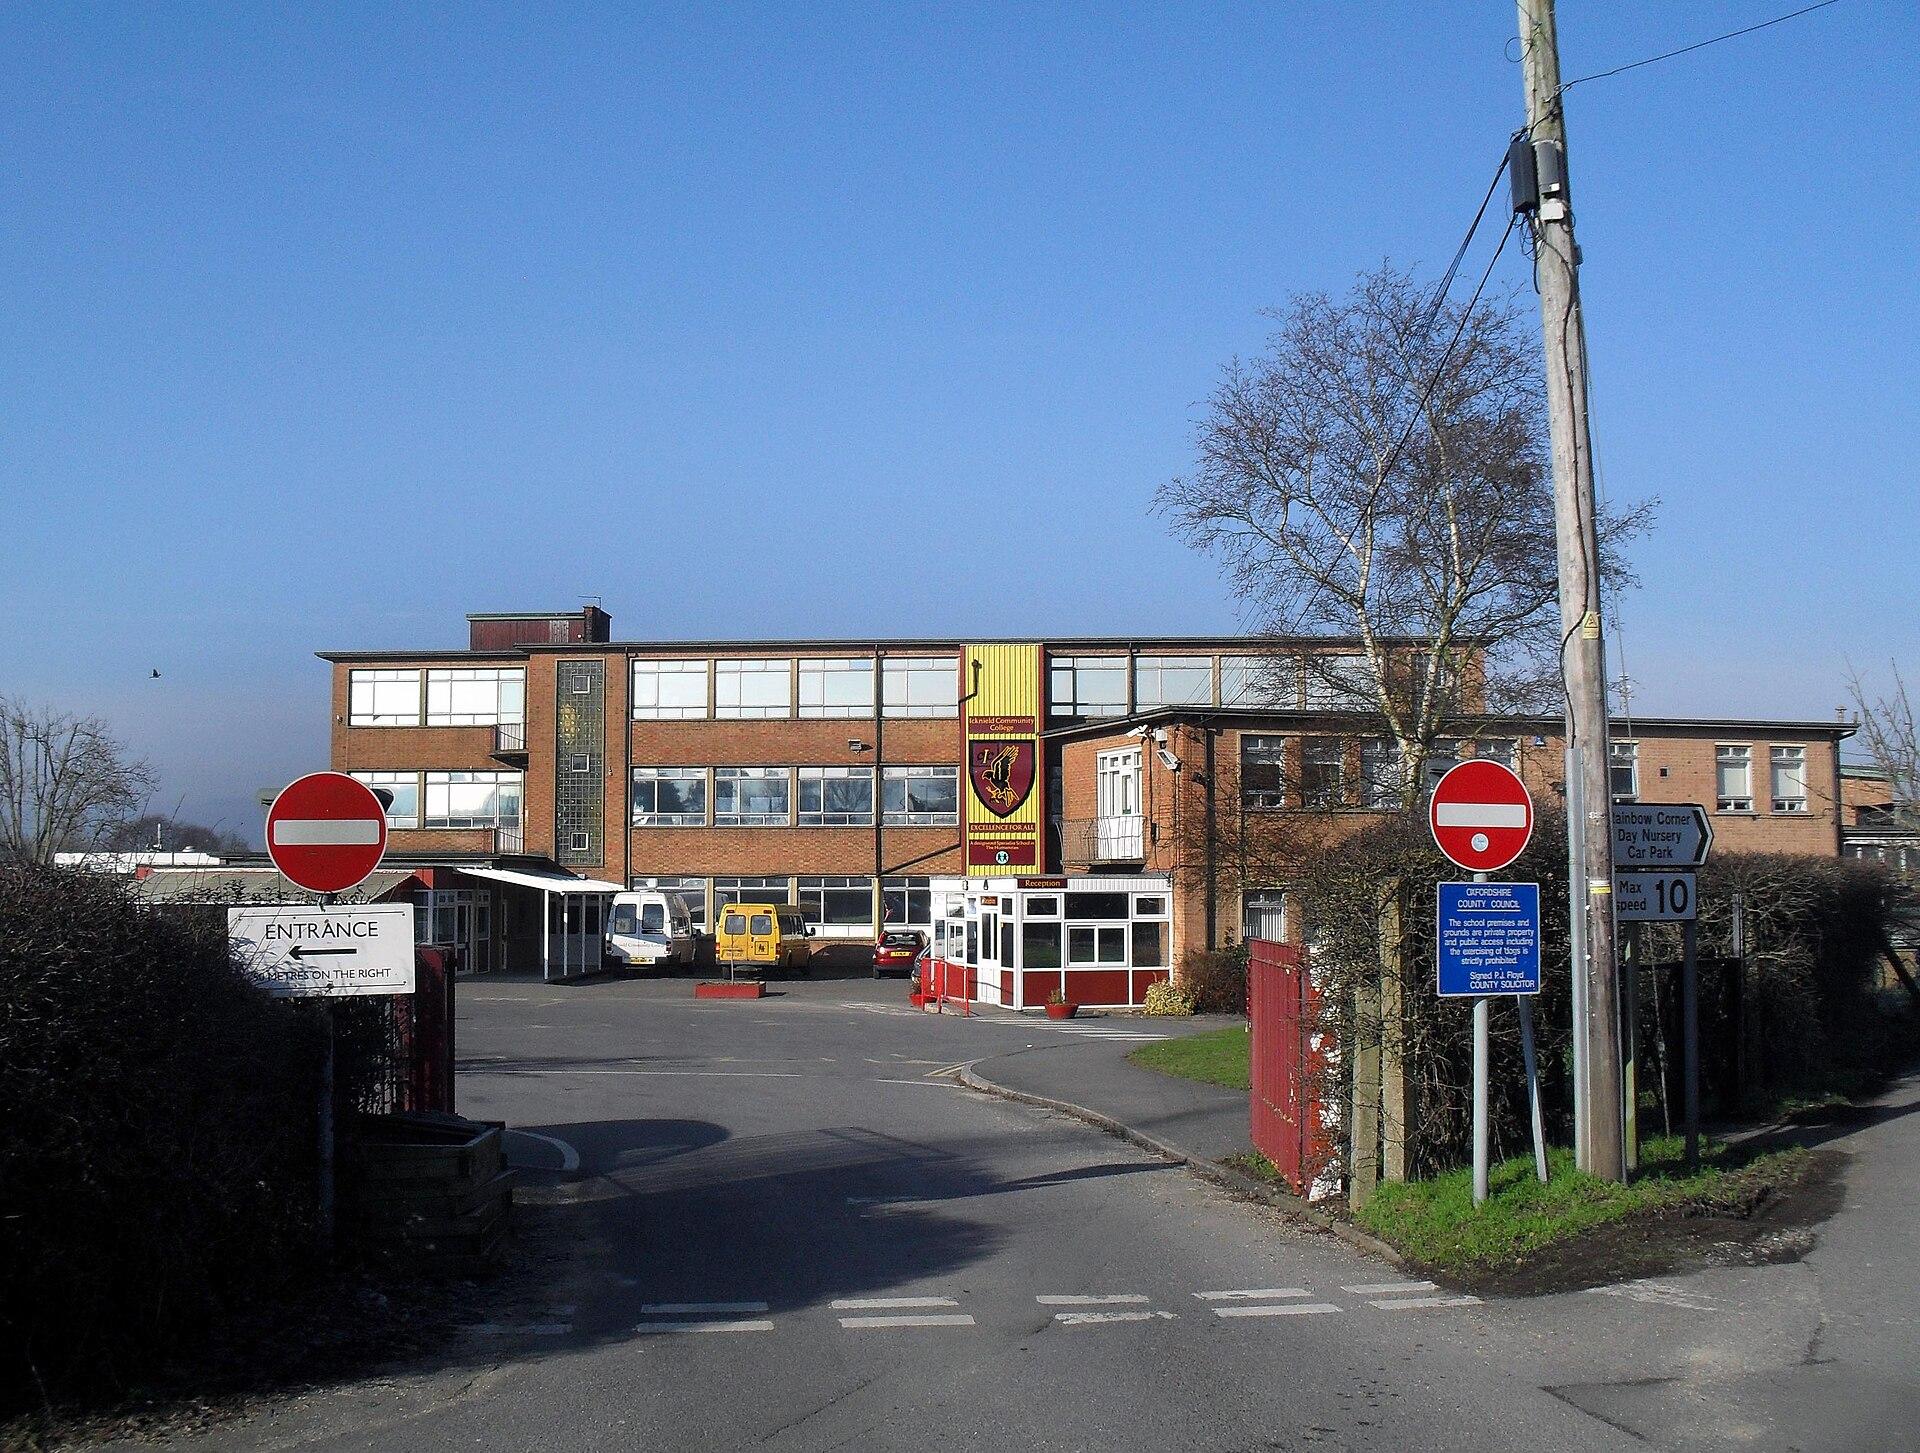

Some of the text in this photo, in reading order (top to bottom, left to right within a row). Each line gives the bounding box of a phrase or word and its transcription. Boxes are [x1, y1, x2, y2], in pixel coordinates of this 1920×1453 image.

[995, 717, 1034, 725] Community
[1656, 811, 1691, 825] Corner
[1618, 828, 1682, 844] Day Nursery
[1627, 845, 1673, 859] Car Park
[1024, 879, 1061, 888] Reception
[1619, 880, 1642, 894] Max
[1466, 888, 1512, 897] OXFORDSHIRE
[1654, 878, 1689, 914] 10
[1457, 900, 1520, 908] COUNTY COUNCIL
[1448, 918, 1530, 928] The school premises and
[265, 921, 379, 940] ENTRANCE
[1443, 929, 1470, 938] grounds
[1483, 928, 1506, 938] private
[1507, 929, 1534, 938] property
[1444, 938, 1457, 946] and
[1459, 938, 1479, 947] public
[1506, 938, 1534, 947] including
[1449, 947, 1529, 957] the exercising of dogs is
[1461, 957, 1518, 966] strictly prohibited.
[269, 970, 309, 981] METRES
[311, 970, 330, 980] ON
[333, 969, 355, 979] THE
[358, 968, 392, 978] RIGHT
[1469, 971, 1493, 980] Signed
[1506, 971, 1525, 980] Floyd
[1469, 980, 1535, 989] COUNTY SOLICITOR
